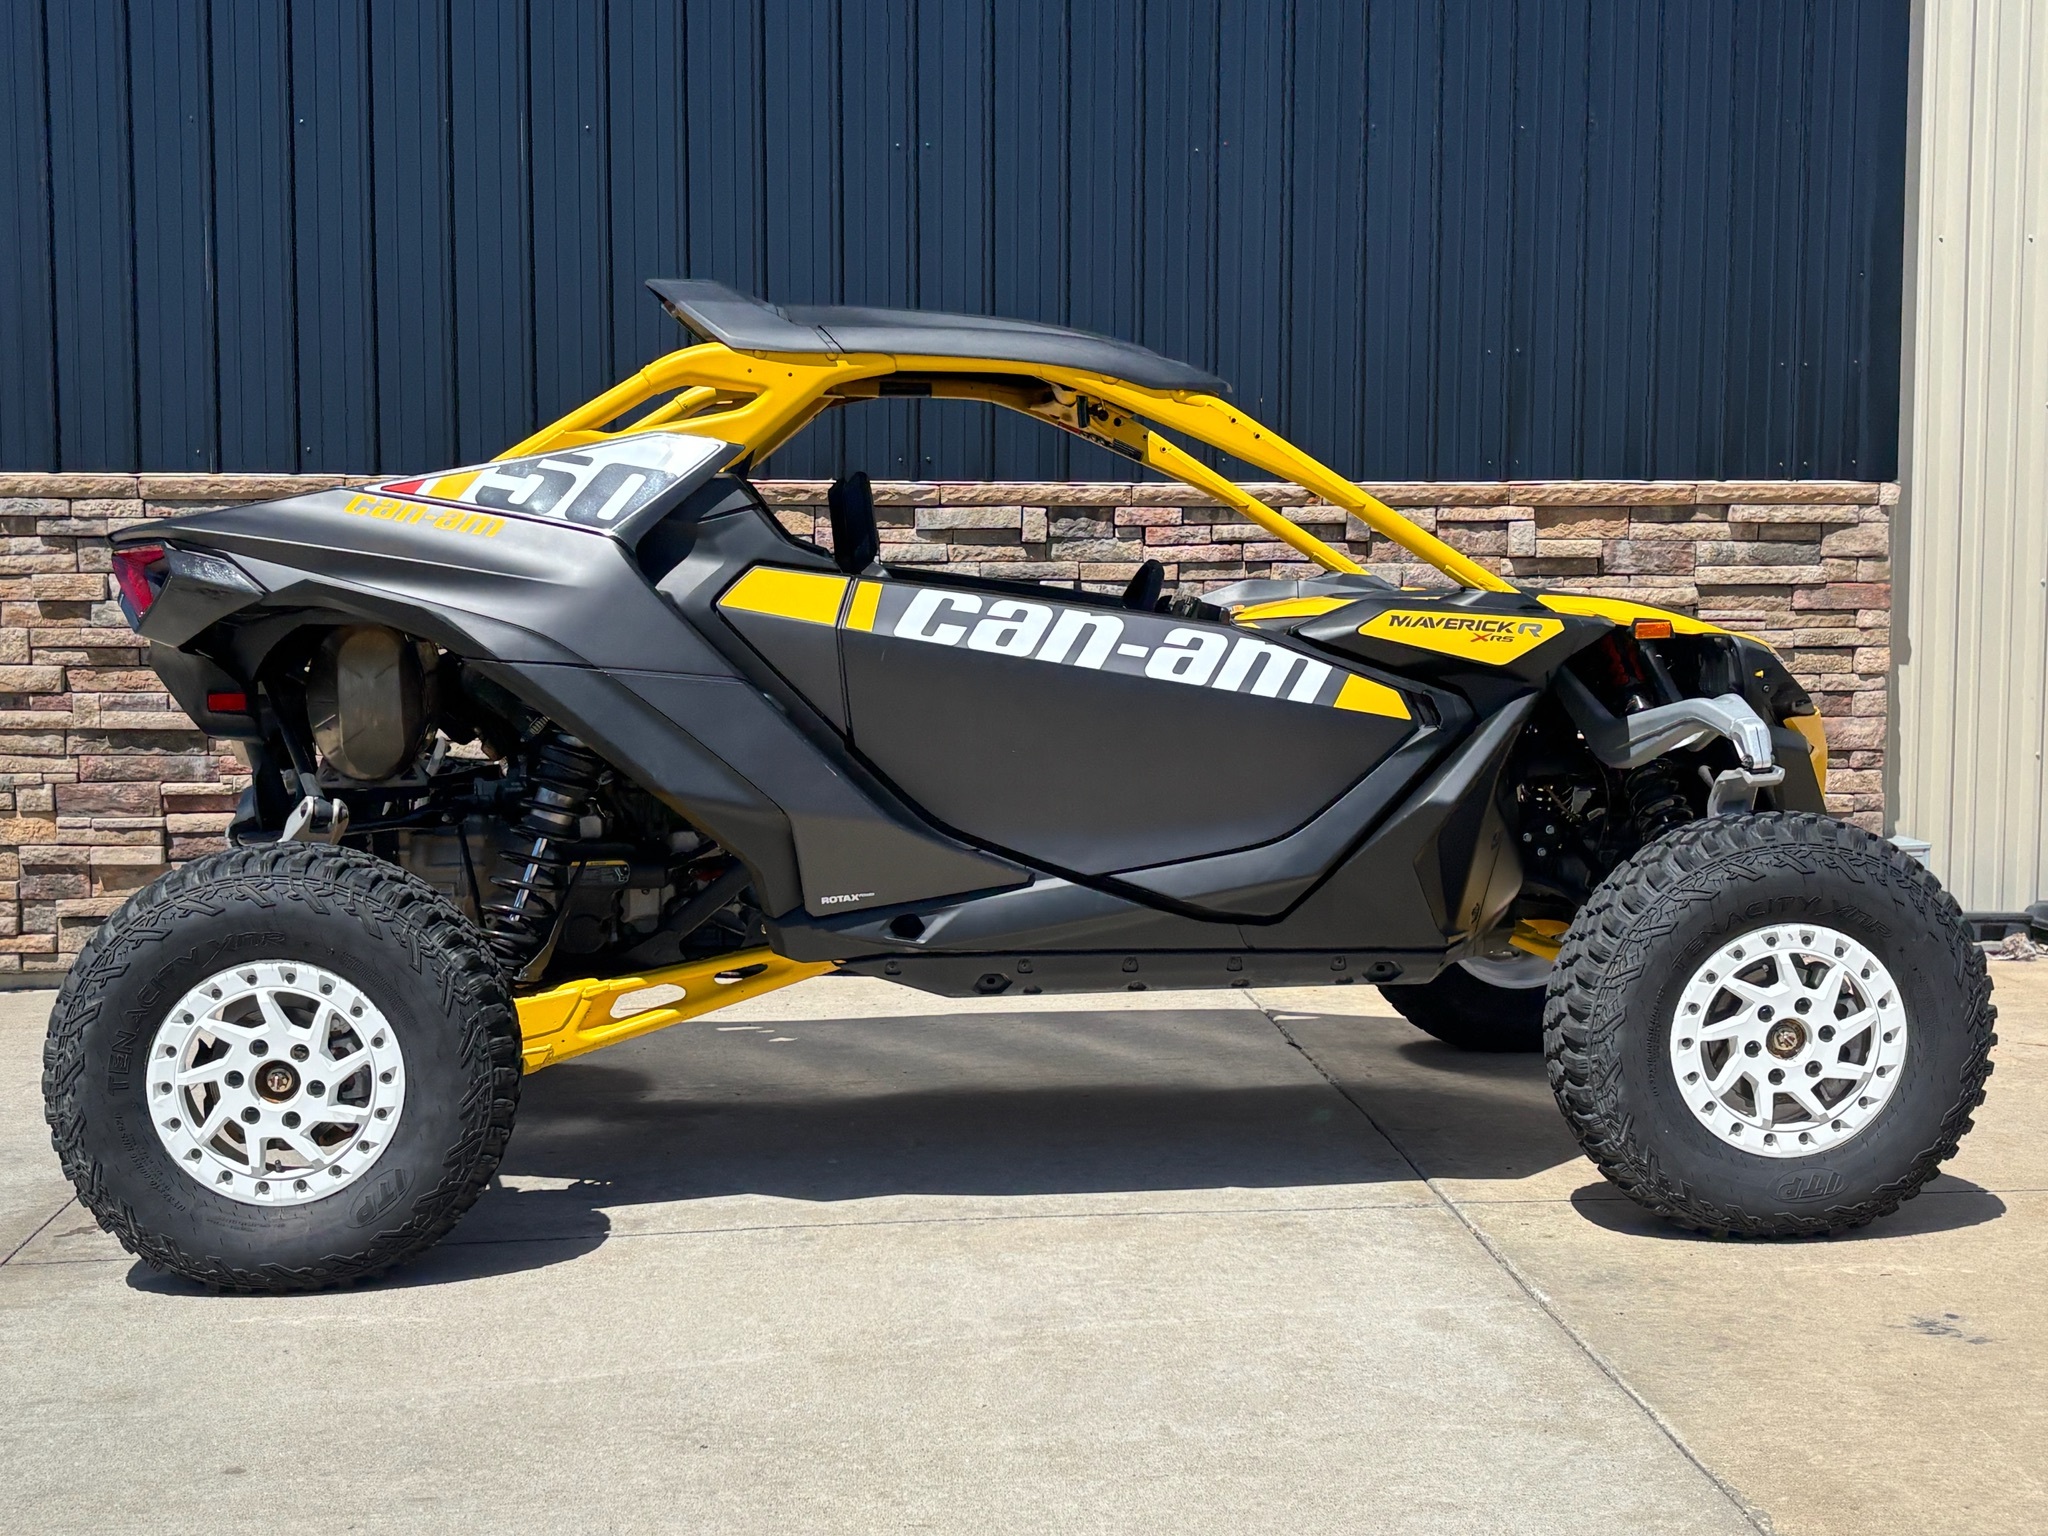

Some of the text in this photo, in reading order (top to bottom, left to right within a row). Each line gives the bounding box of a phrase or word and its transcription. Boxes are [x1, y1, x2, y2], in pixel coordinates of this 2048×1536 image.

[343, 494, 506, 538] can-am
[893, 588, 1333, 704] can-am
[1388, 614, 1545, 638] MAVERICK R
[821, 893, 860, 905] ROTAX
[1670, 895, 1823, 972] TENACITY
[107, 945, 201, 1096] TENACITY
[356, 1168, 408, 1225] ITP
[1776, 1171, 1844, 1201] ITP
